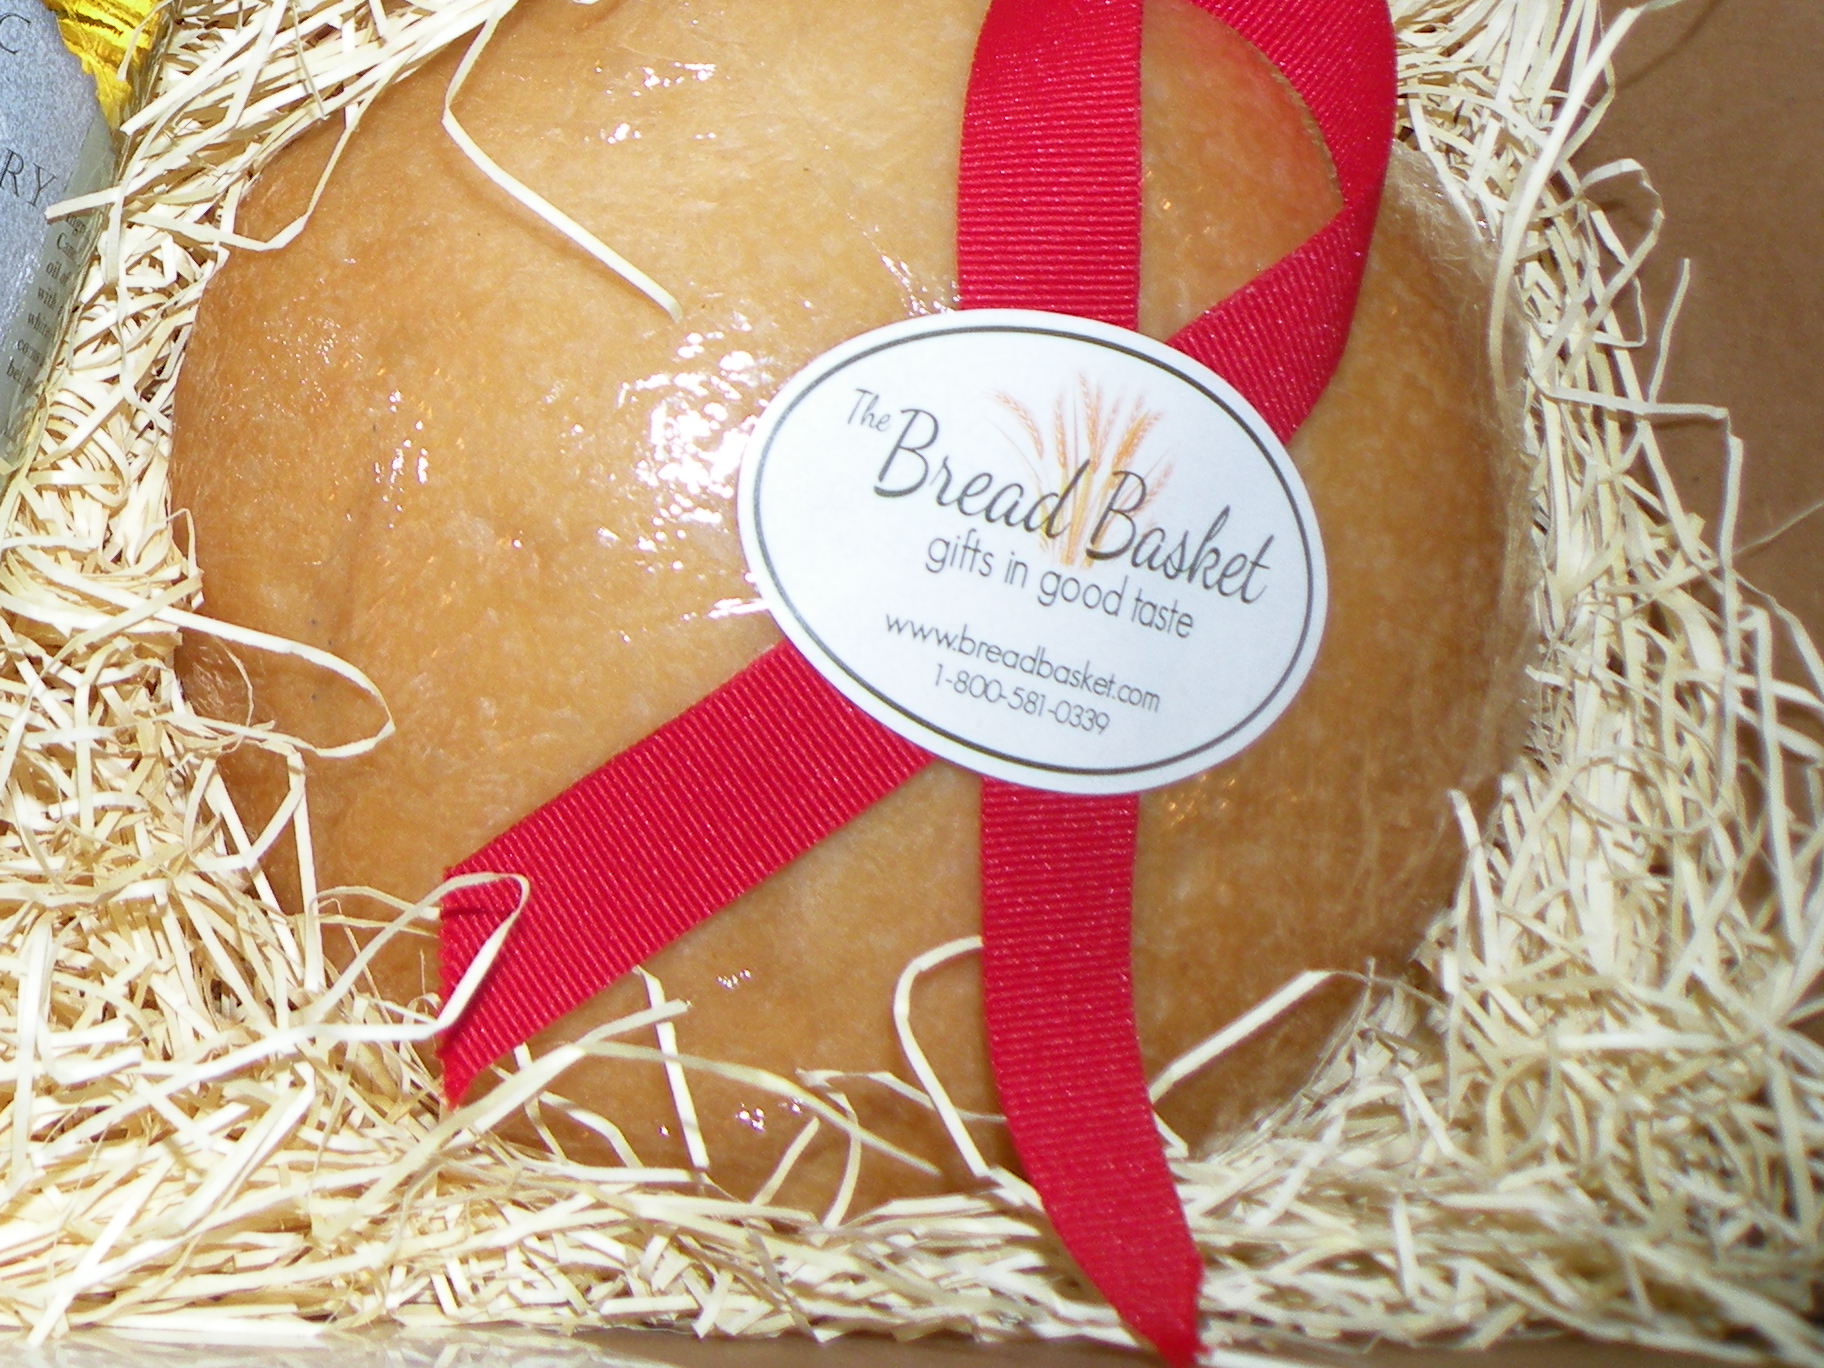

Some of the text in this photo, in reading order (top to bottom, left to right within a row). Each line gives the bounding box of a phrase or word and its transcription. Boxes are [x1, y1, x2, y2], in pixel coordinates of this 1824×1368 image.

[846, 387, 1275, 605] The Bread Basket
[925, 527, 1195, 639] gifts in good taste
[884, 613, 1162, 714] www.breadbasket.com
[933, 663, 1112, 736] 1-800-581-0339
